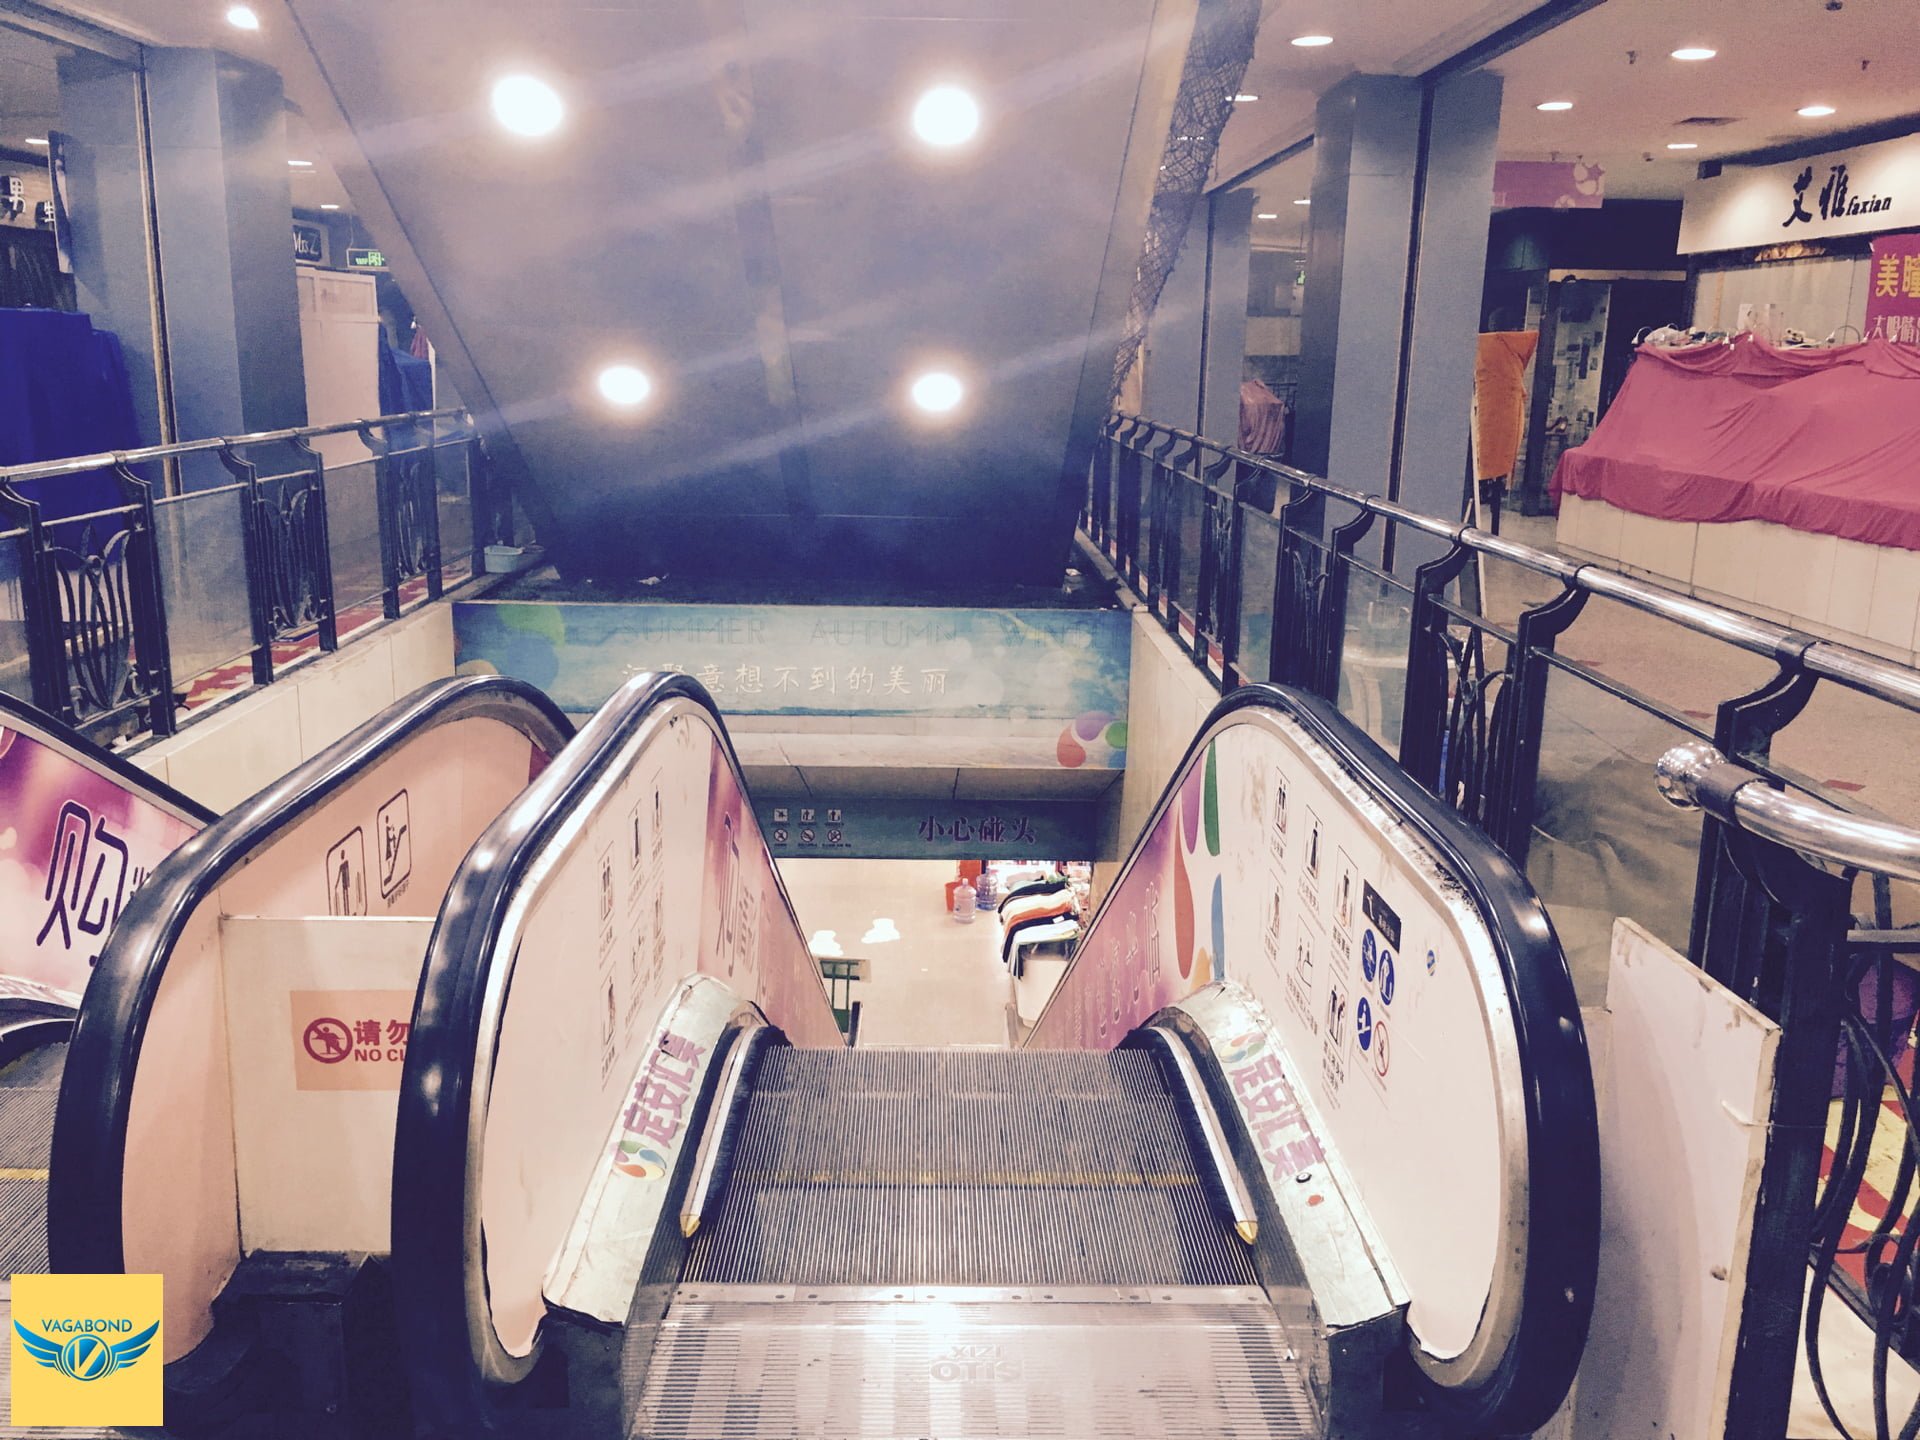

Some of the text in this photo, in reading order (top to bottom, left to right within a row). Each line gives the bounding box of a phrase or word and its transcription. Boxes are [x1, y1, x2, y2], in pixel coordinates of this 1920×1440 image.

[1845, 194, 1892, 216] faxian
[809, 618, 957, 649] AUTUMN
[354, 1048, 382, 1062] NO
